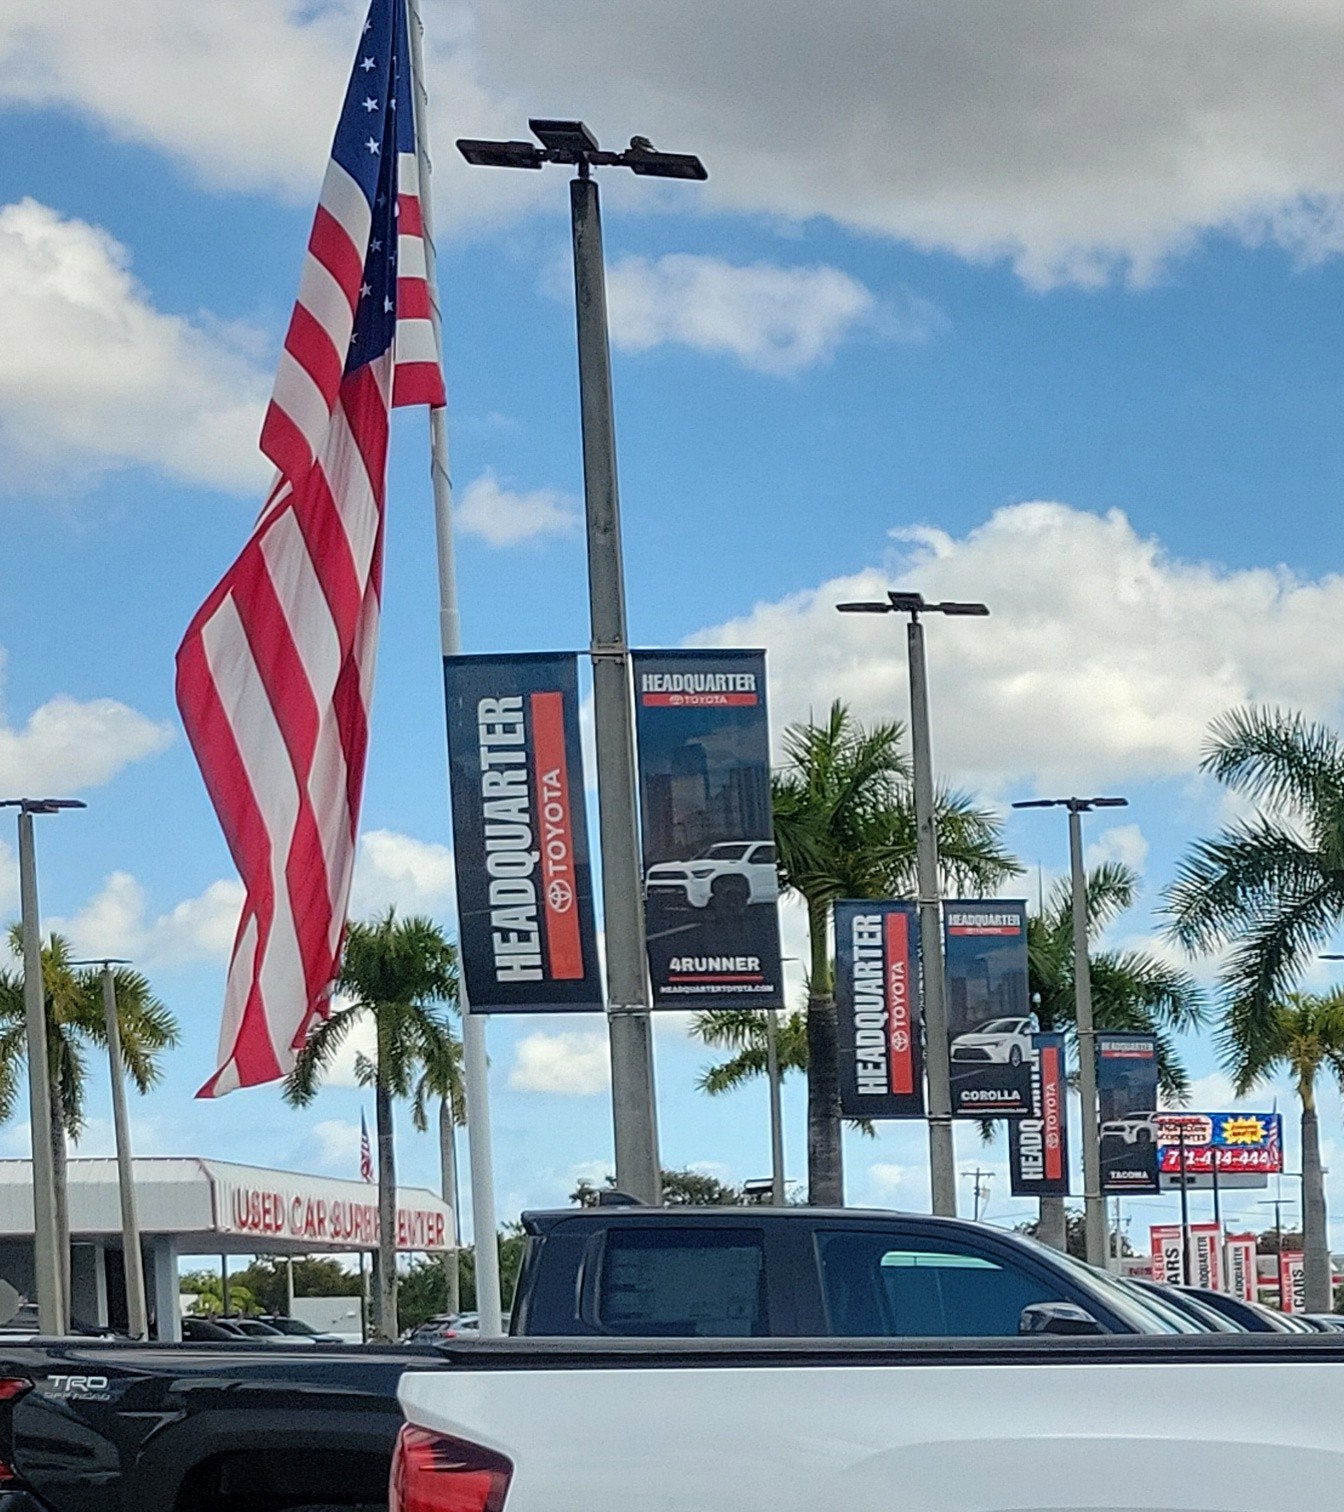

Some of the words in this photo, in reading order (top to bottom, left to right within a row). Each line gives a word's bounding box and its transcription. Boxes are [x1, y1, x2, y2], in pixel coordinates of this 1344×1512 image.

[641, 673, 757, 694] HEADQUARTER
[683, 694, 728, 705] TOYOTA
[476, 694, 544, 983] HEADQUARTER
[541, 768, 569, 877] TOYOTA
[948, 913, 1021, 927] HEADQUARTER
[668, 956, 760, 973] 4RUNNER
[852, 913, 889, 1096] HEADQUARTER
[890, 960, 907, 1029] TOYOTA
[960, 1089, 1021, 1102] COROLLA
[1046, 1083, 1059, 1131] TOYOTA
[1109, 1170, 1149, 1180] TACOMA
[236, 1187, 285, 1232] USED
[290, 1196, 327, 1237] CAR
[396, 1208, 445, 1246] ENTER
[1153, 1253, 1165, 1281] SED
[1165, 1248, 1181, 1285] ARS
[1197, 1235, 1210, 1288] ADQUARTER
[47, 1374, 108, 1392] TRD
